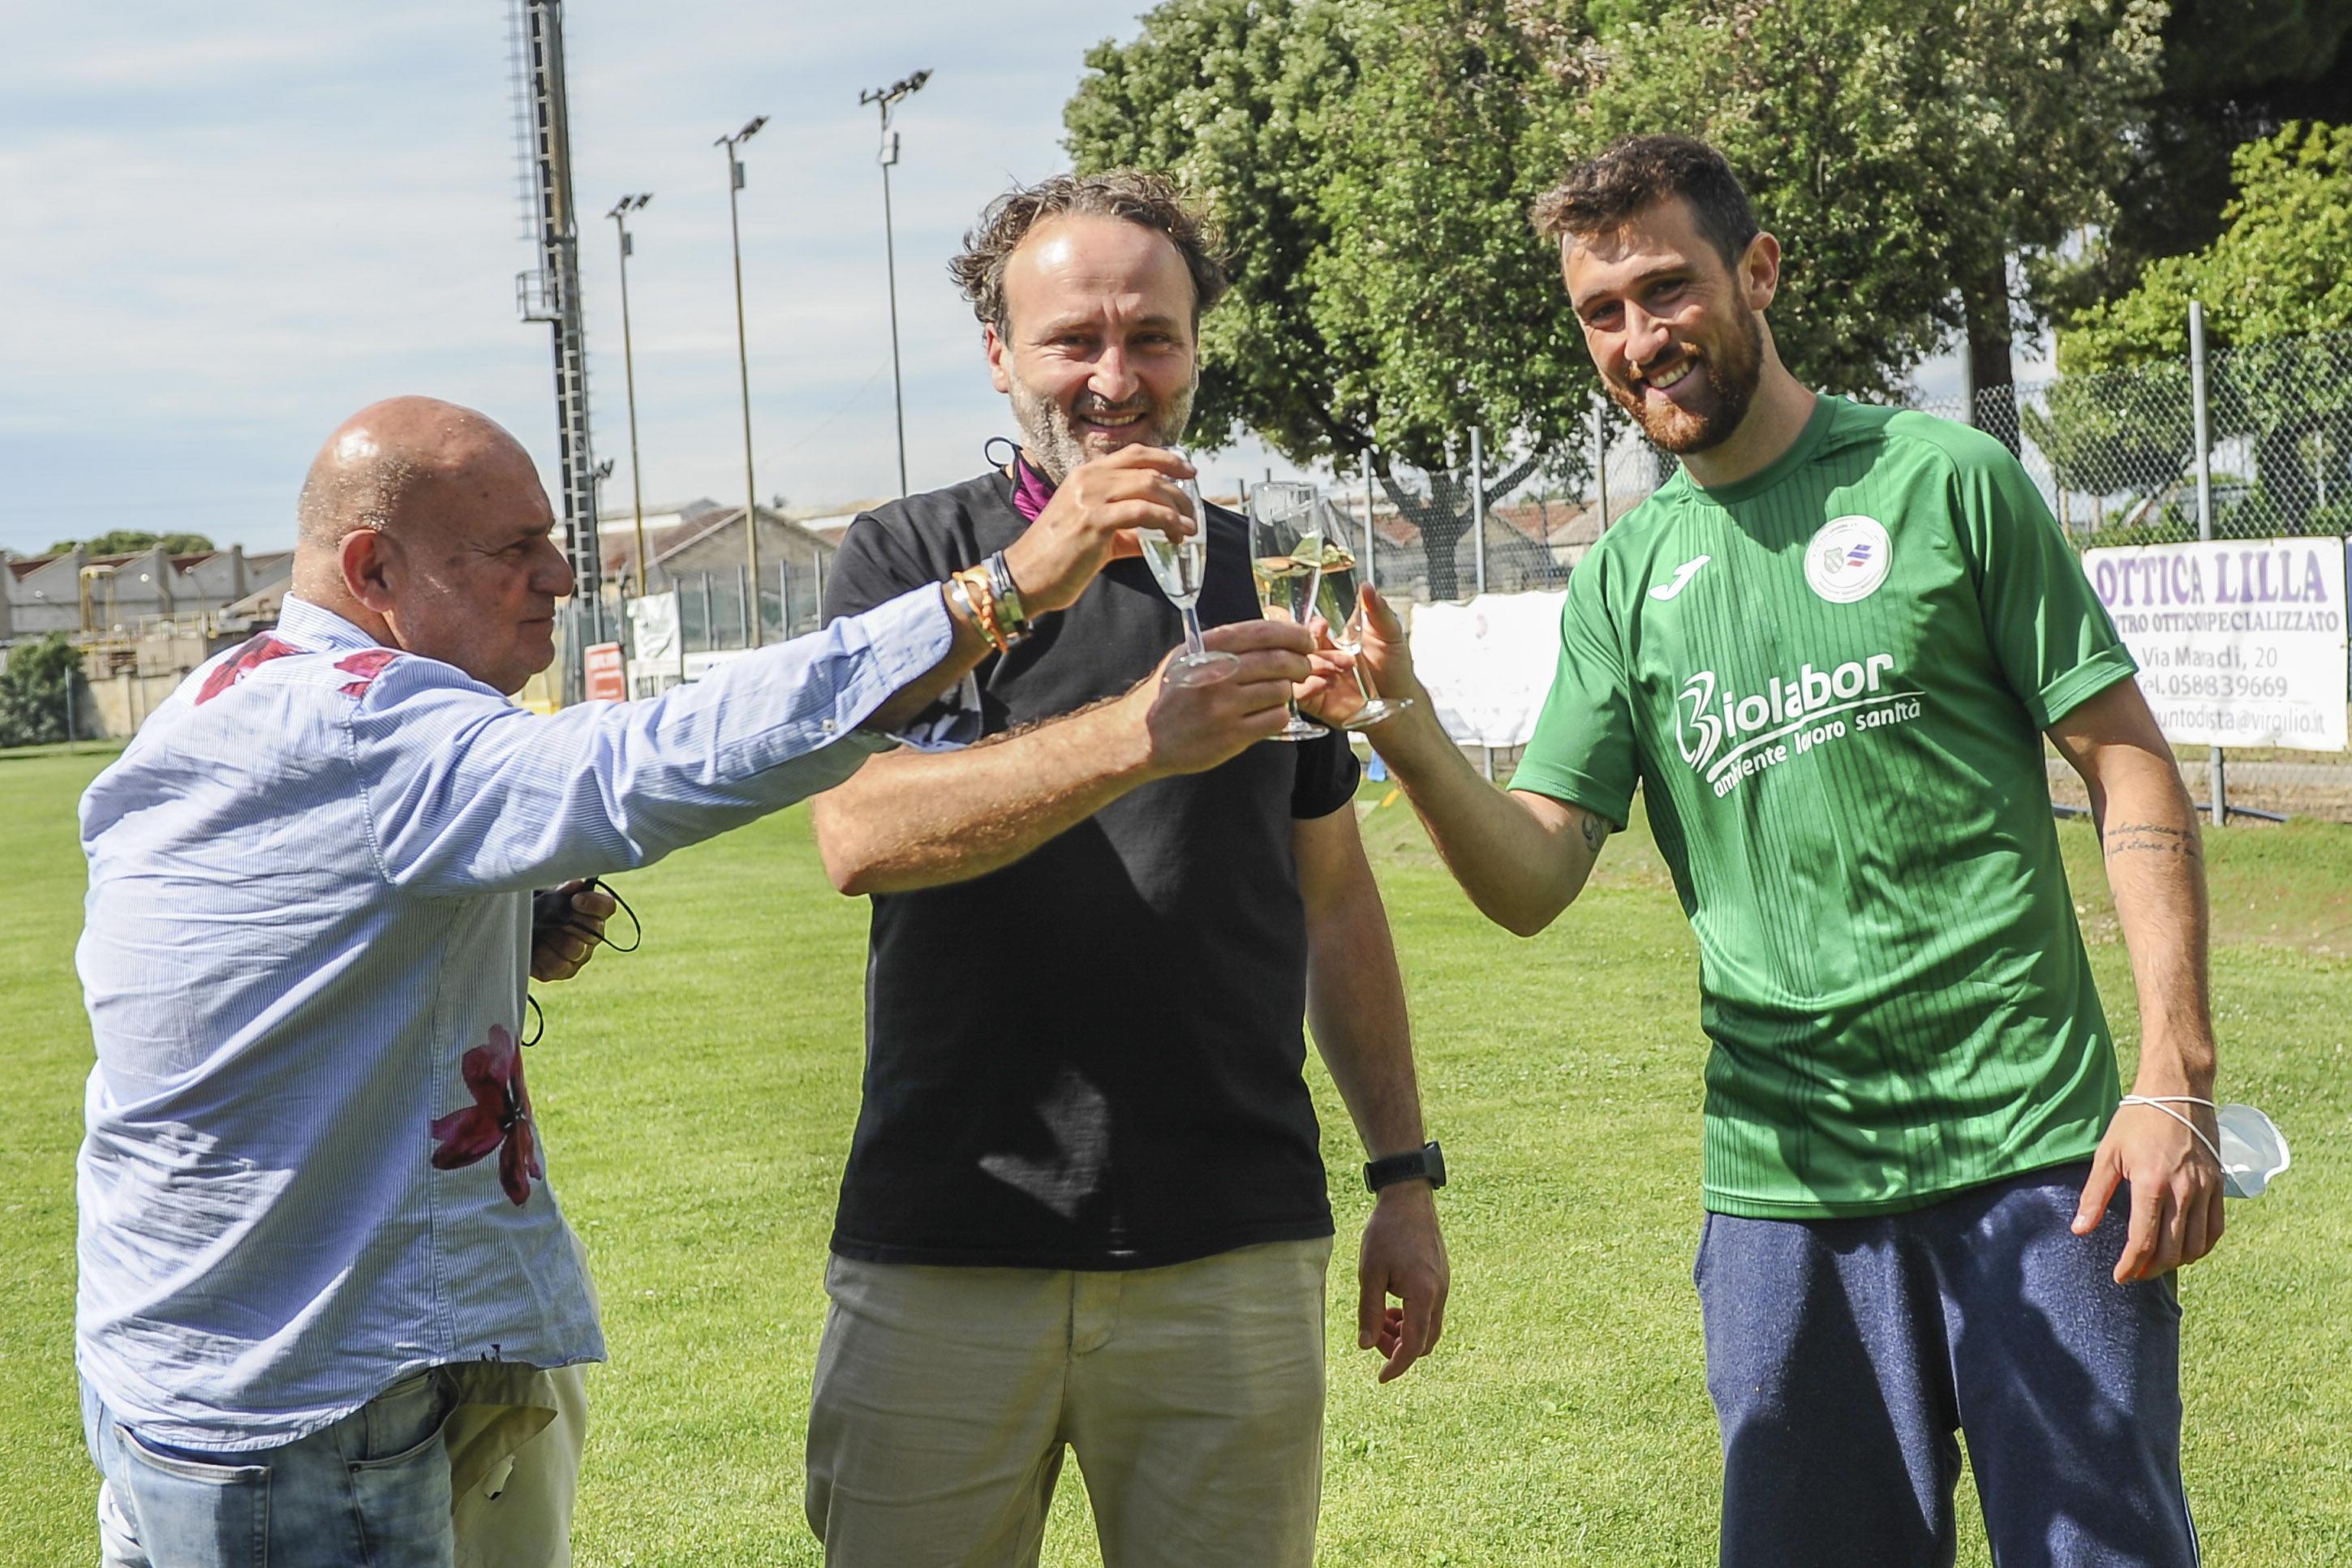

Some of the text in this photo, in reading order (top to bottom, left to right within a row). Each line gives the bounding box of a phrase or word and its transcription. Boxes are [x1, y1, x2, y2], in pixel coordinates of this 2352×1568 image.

[2096, 549, 2328, 607] OTTICA LILLA
[2204, 611, 2339, 632] PECIALIZZATO
[2142, 647, 2170, 668] Via
[2255, 647, 2277, 668] 20
[1675, 652, 1895, 773] Biolabor
